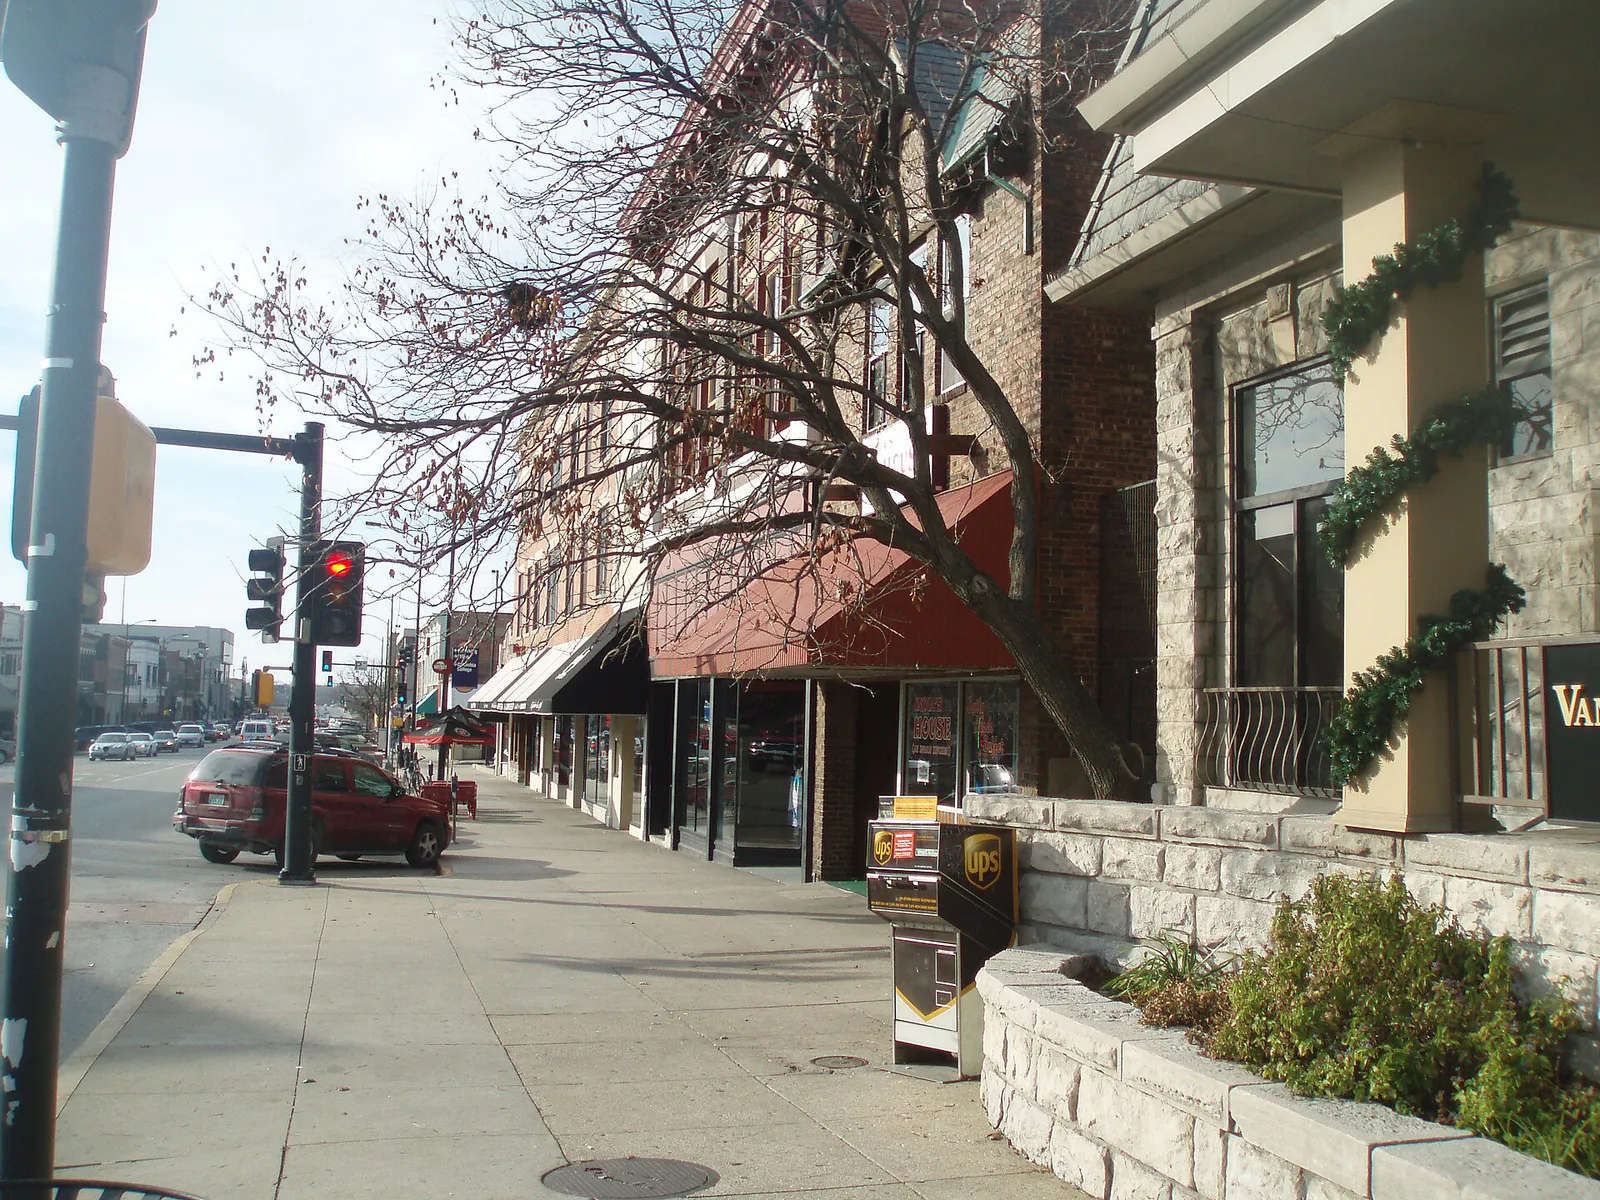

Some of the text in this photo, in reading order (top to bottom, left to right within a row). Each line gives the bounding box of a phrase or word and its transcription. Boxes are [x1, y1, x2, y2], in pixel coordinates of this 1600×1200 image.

[913, 716, 952, 741] HOUSE
[875, 840, 892, 860] ups
[967, 848, 999, 882] ups
